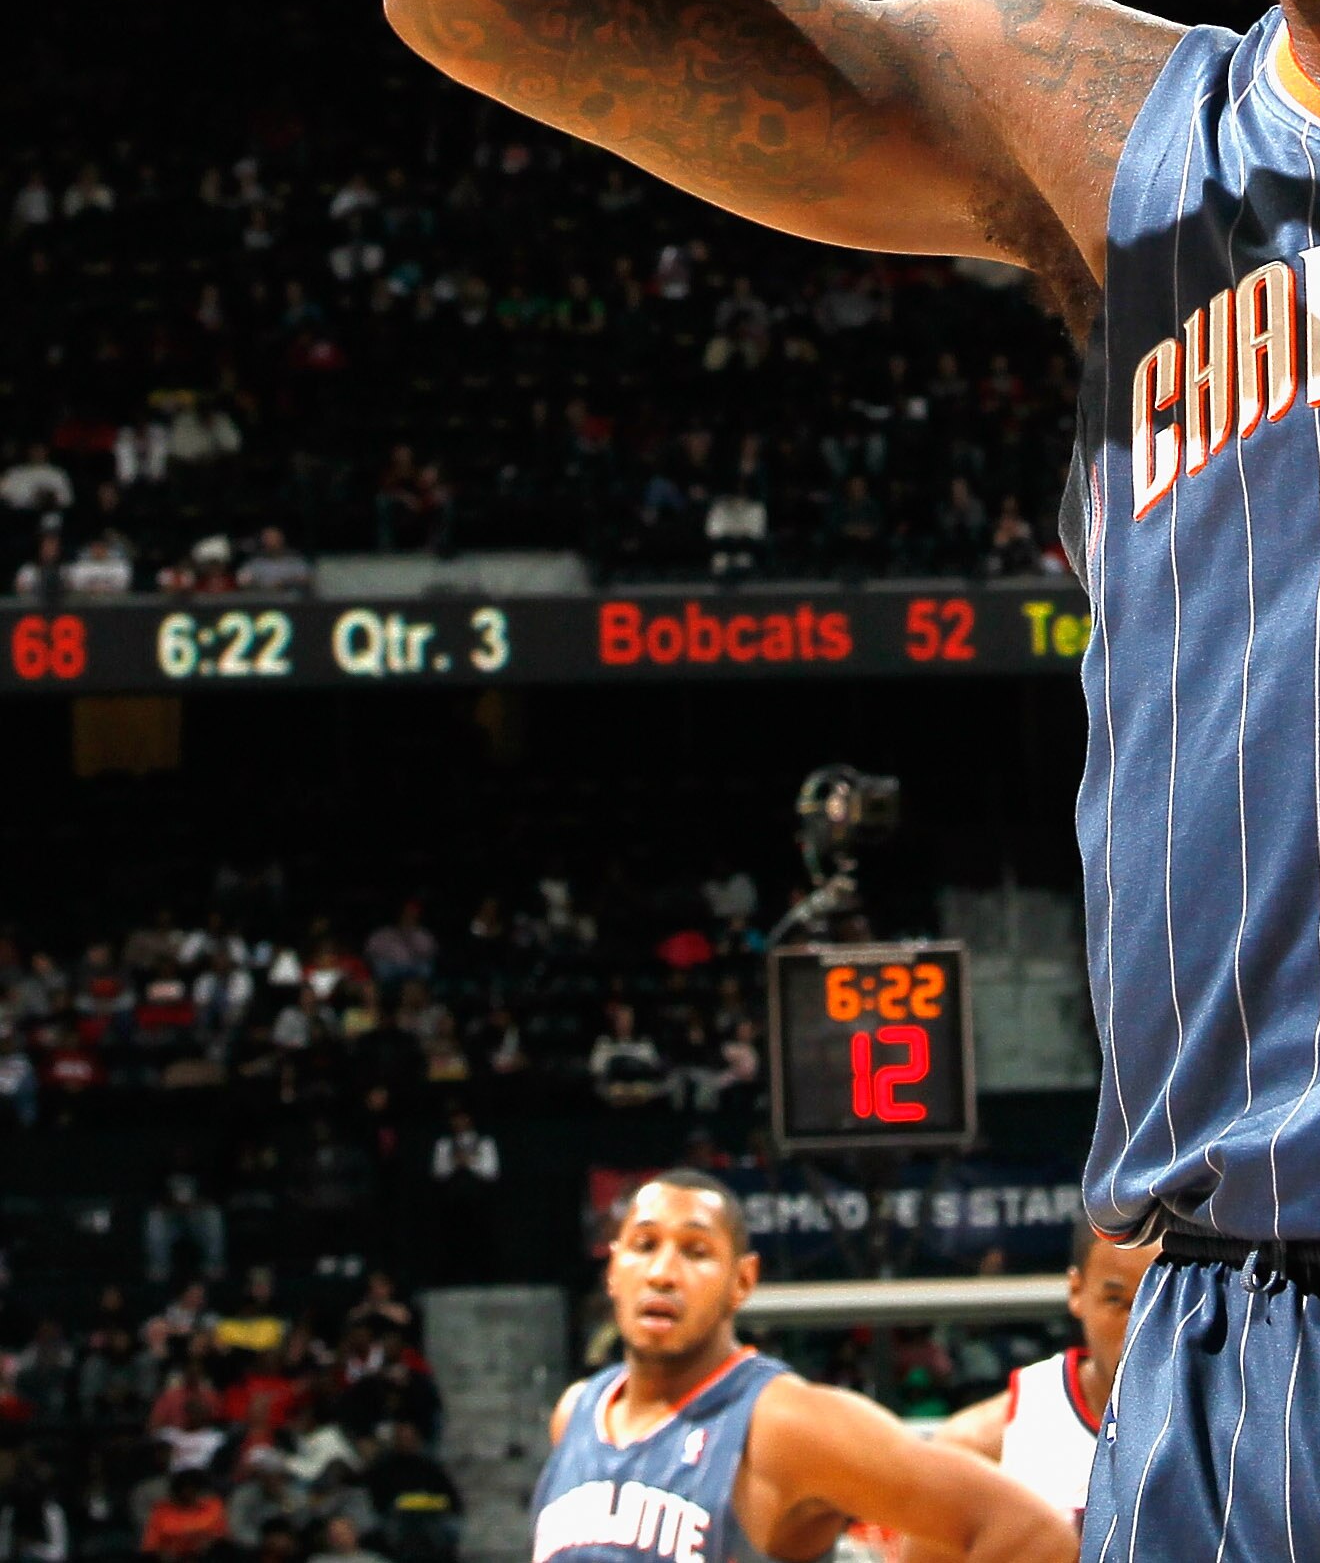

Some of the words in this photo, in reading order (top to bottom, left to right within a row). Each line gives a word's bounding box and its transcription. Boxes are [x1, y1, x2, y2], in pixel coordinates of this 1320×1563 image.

[13, 615, 87, 679] 68
[157, 611, 292, 679] 6:22
[331, 609, 450, 678] Qtr.
[469, 607, 510, 673] 3
[600, 599, 853, 667] Bobcats
[905, 598, 976, 663] 52
[824, 962, 946, 1022] 6:22
[850, 1023, 931, 1123] 12
